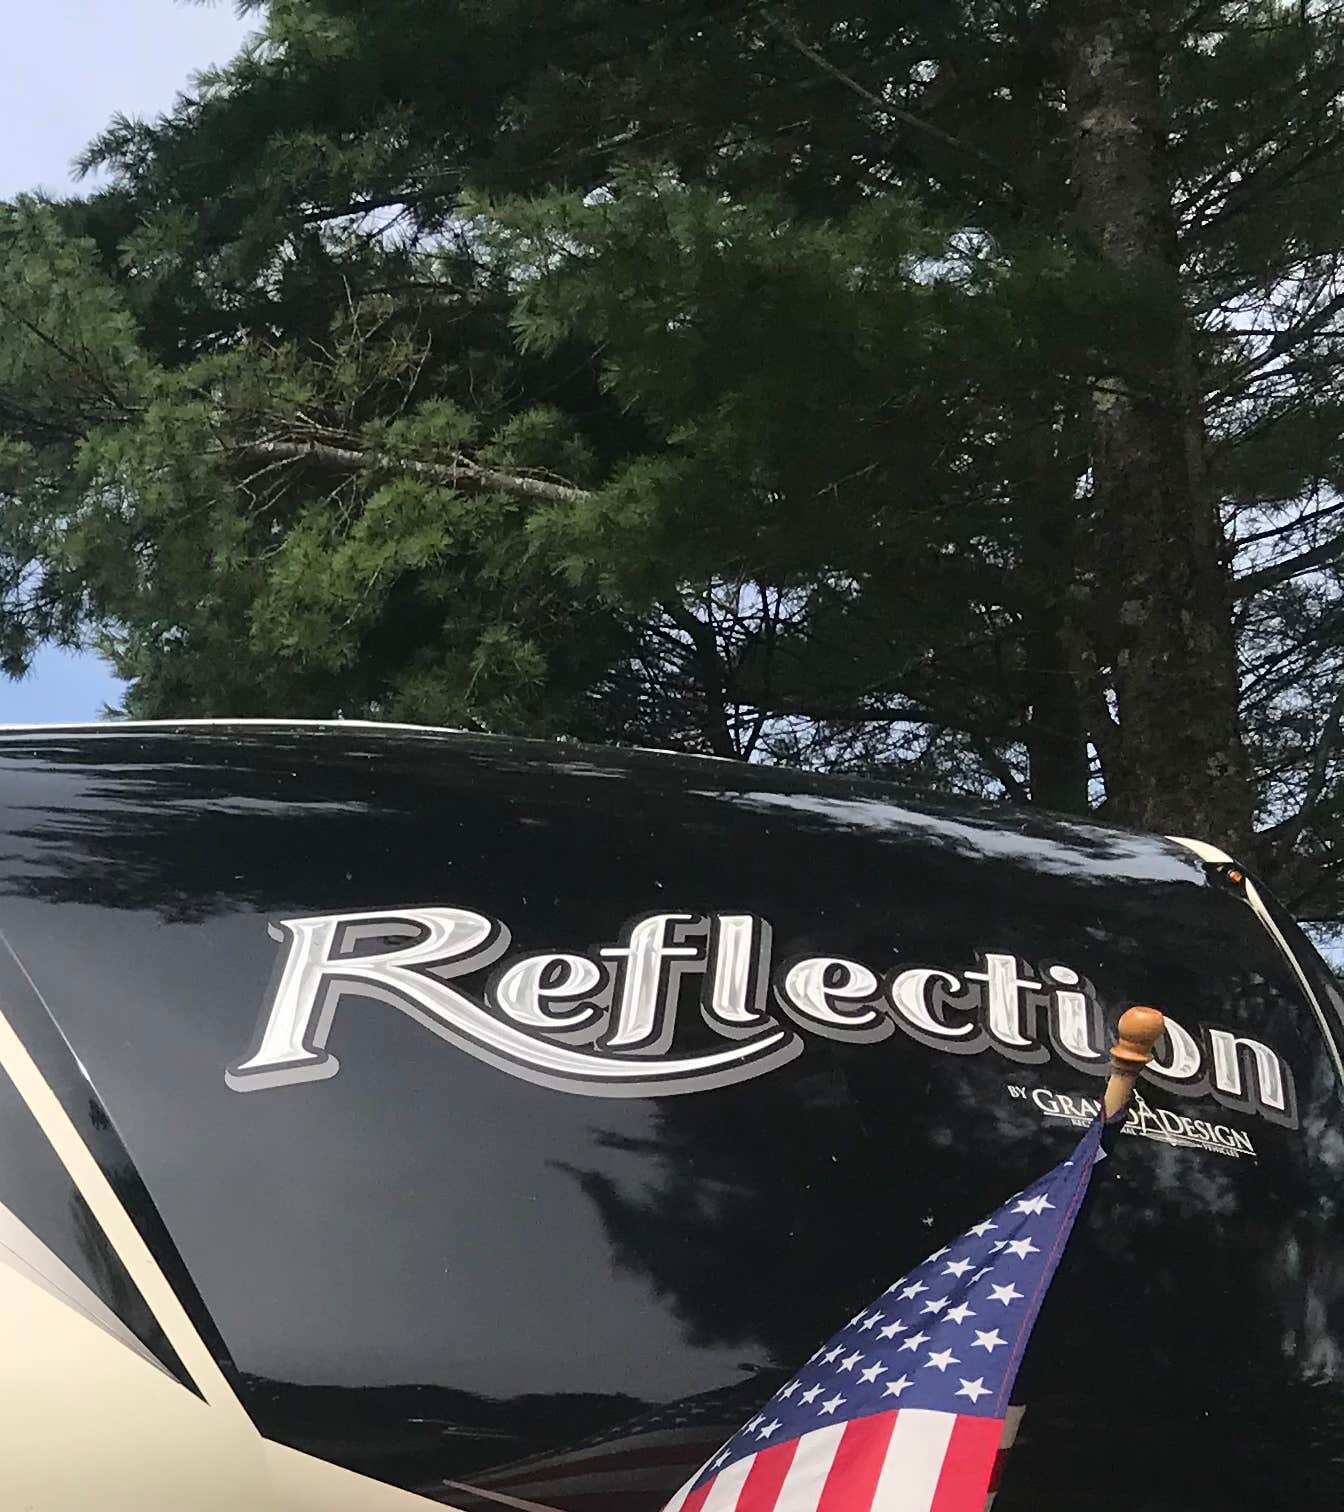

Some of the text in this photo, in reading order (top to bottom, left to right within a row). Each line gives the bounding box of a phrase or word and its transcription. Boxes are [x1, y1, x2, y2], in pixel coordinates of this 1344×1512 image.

[225, 906, 1299, 1130] Reflection
[1007, 1085, 1027, 1100] BY
[1155, 1108, 1254, 1152] DESIGN
